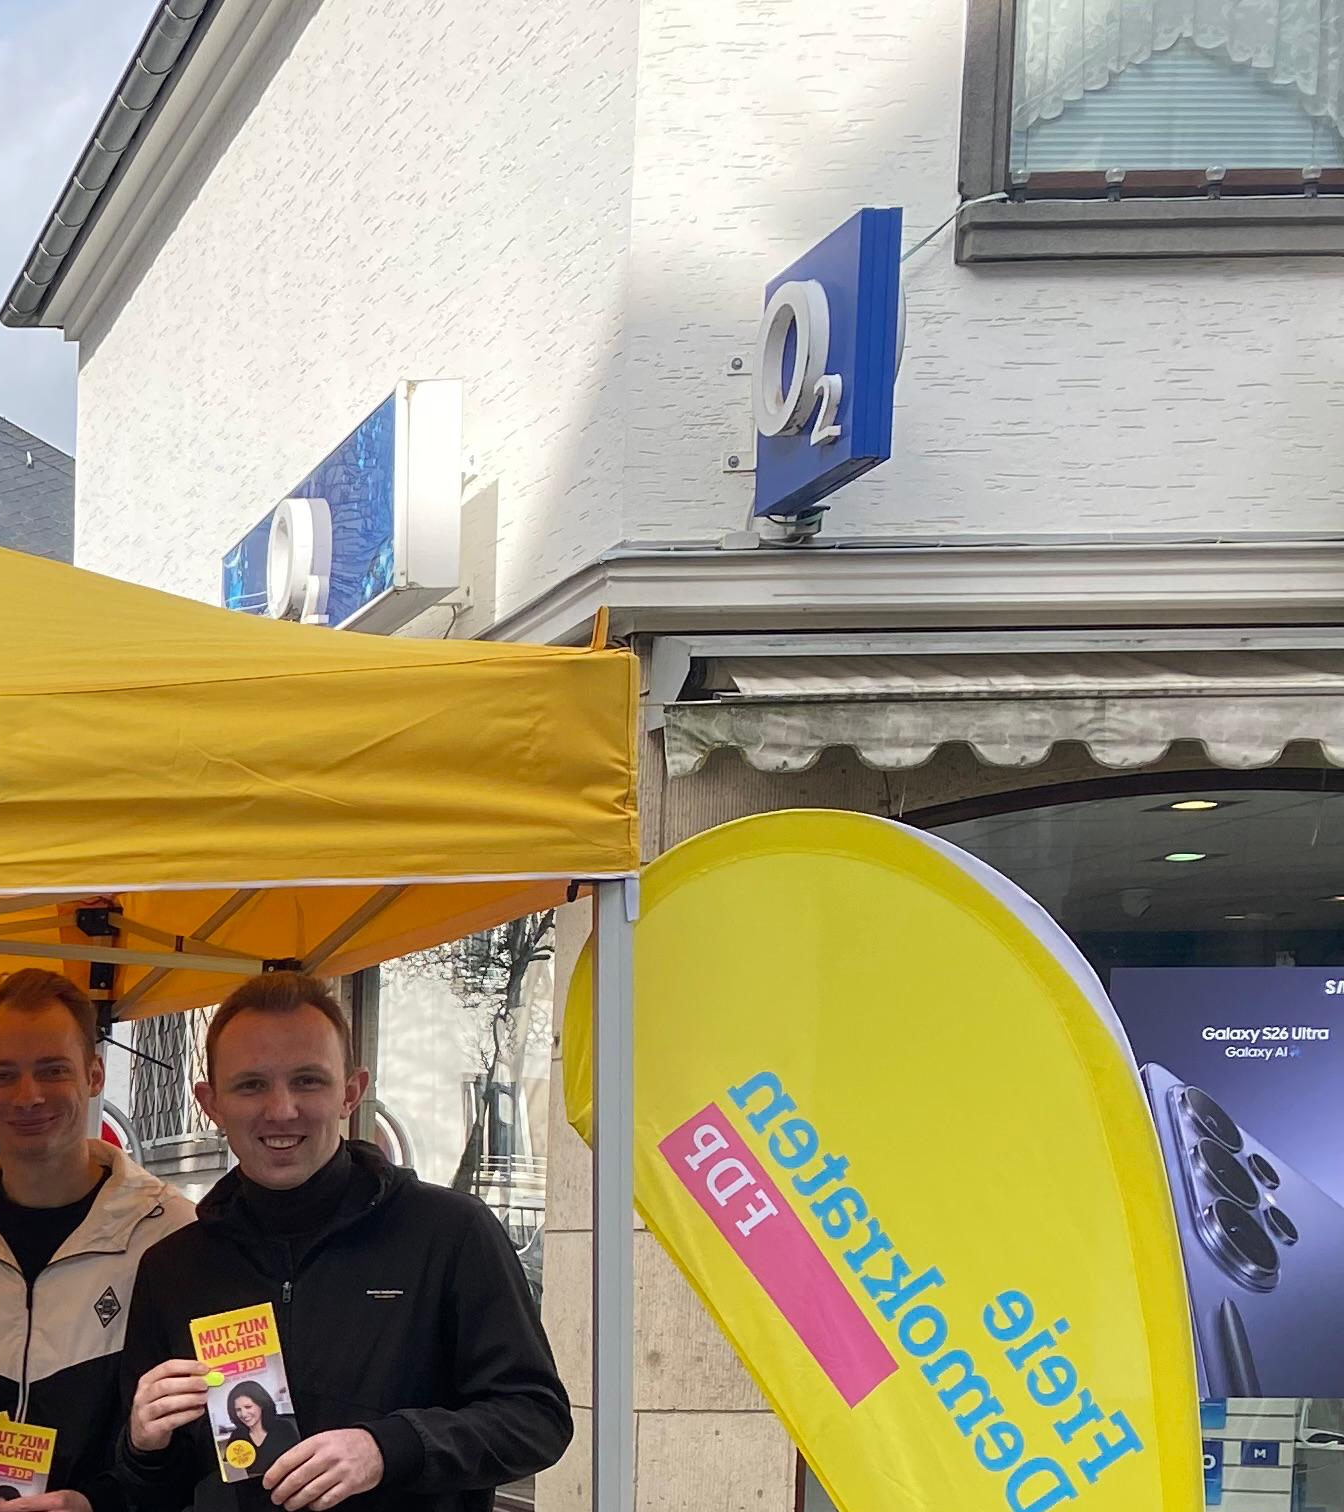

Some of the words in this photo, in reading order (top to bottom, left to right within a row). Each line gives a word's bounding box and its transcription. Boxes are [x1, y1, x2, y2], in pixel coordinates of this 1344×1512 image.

[1202, 1026, 1260, 1043] Galaxy
[1262, 1026, 1289, 1040] S26
[1291, 1026, 1330, 1040] Ultra
[1225, 1046, 1273, 1060] Galaxy
[1275, 1047, 1288, 1057] AI
[198, 1325, 230, 1347] MUT
[237, 1315, 269, 1336] ZUM
[201, 1331, 267, 1361] MACHEN
[238, 1356, 264, 1372] FDP
[20, 1434, 49, 1450] ZUM
[1254, 1448, 1266, 1459] M
[8, 1467, 32, 1480] FDP
